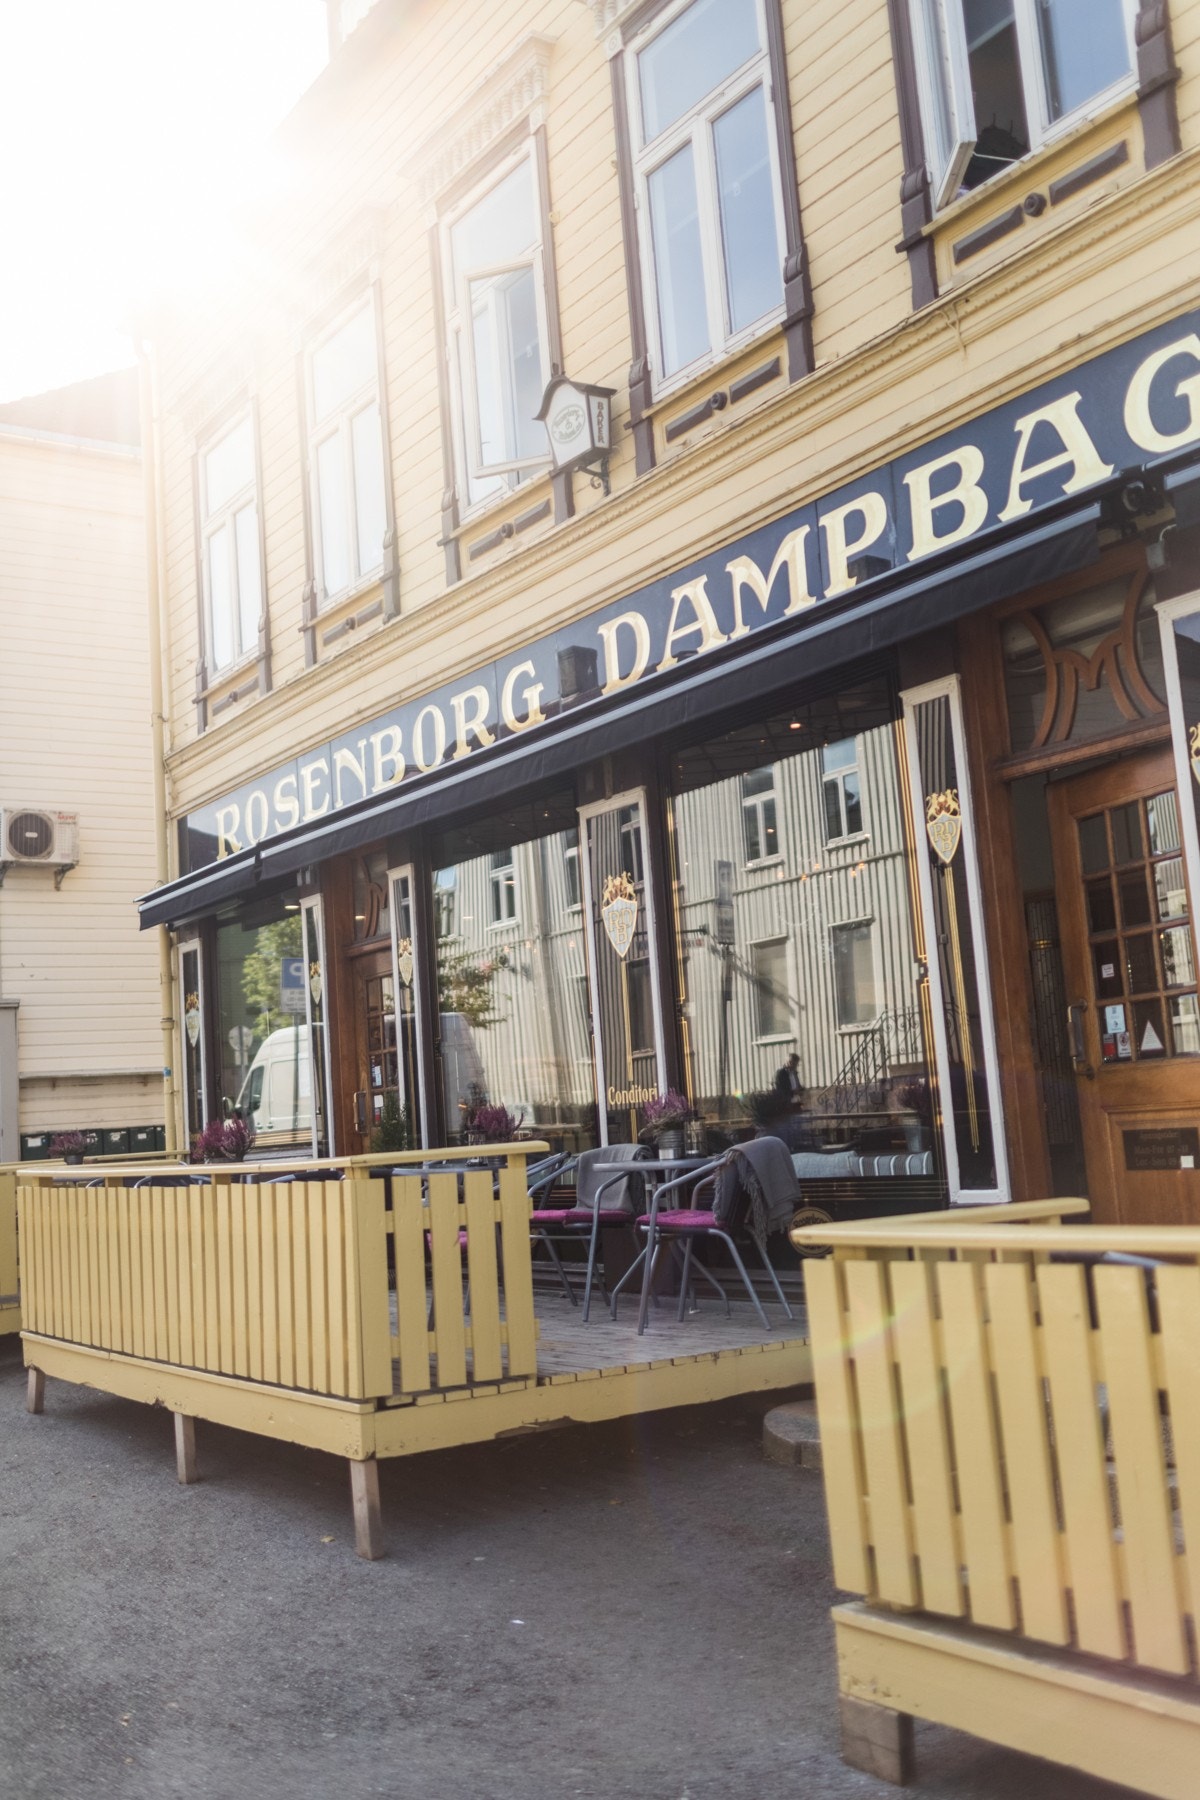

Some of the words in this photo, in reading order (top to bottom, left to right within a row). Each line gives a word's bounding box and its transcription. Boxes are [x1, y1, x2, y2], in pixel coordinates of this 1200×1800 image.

[215, 659, 547, 861] ROSENBORG
[597, 333, 1200, 696] DAMPBAG
[608, 1082, 658, 1105] Conditori
